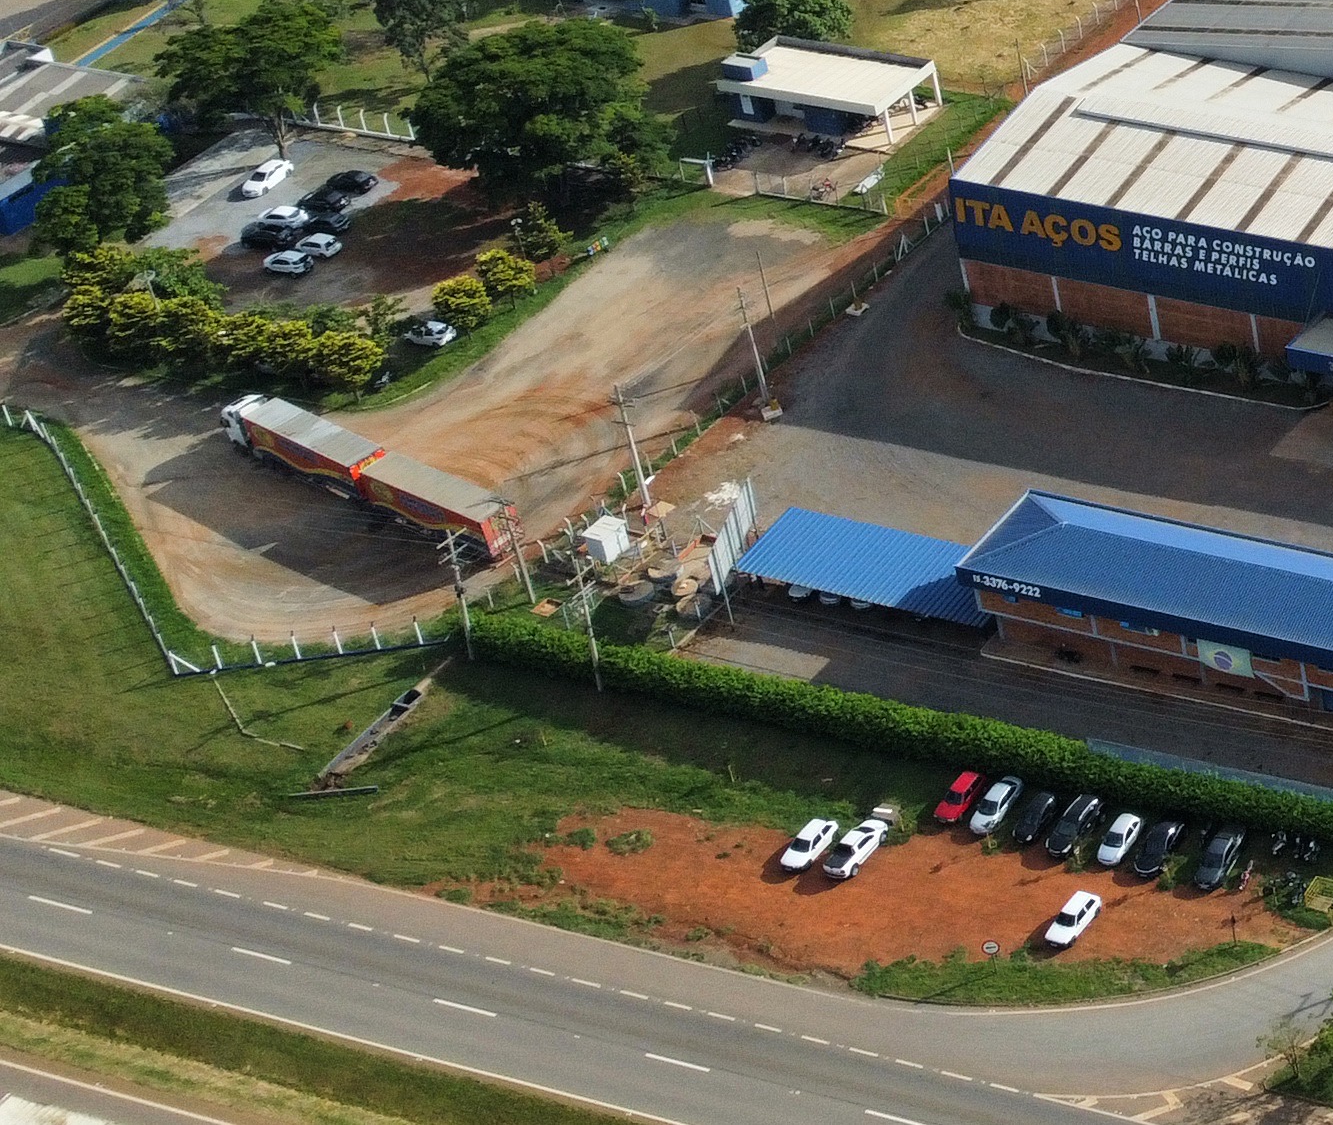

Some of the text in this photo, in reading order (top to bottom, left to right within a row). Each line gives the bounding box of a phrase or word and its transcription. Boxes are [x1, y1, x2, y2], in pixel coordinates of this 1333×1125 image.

[955, 197, 1122, 252] ITA AÇOS
[1132, 225, 1316, 268] AÇO PARA CONSTRUÇÃO
[1133, 236, 1260, 270] BARRAS E PERFIS
[1133, 248, 1278, 285] TELHAS METÁLICAS
